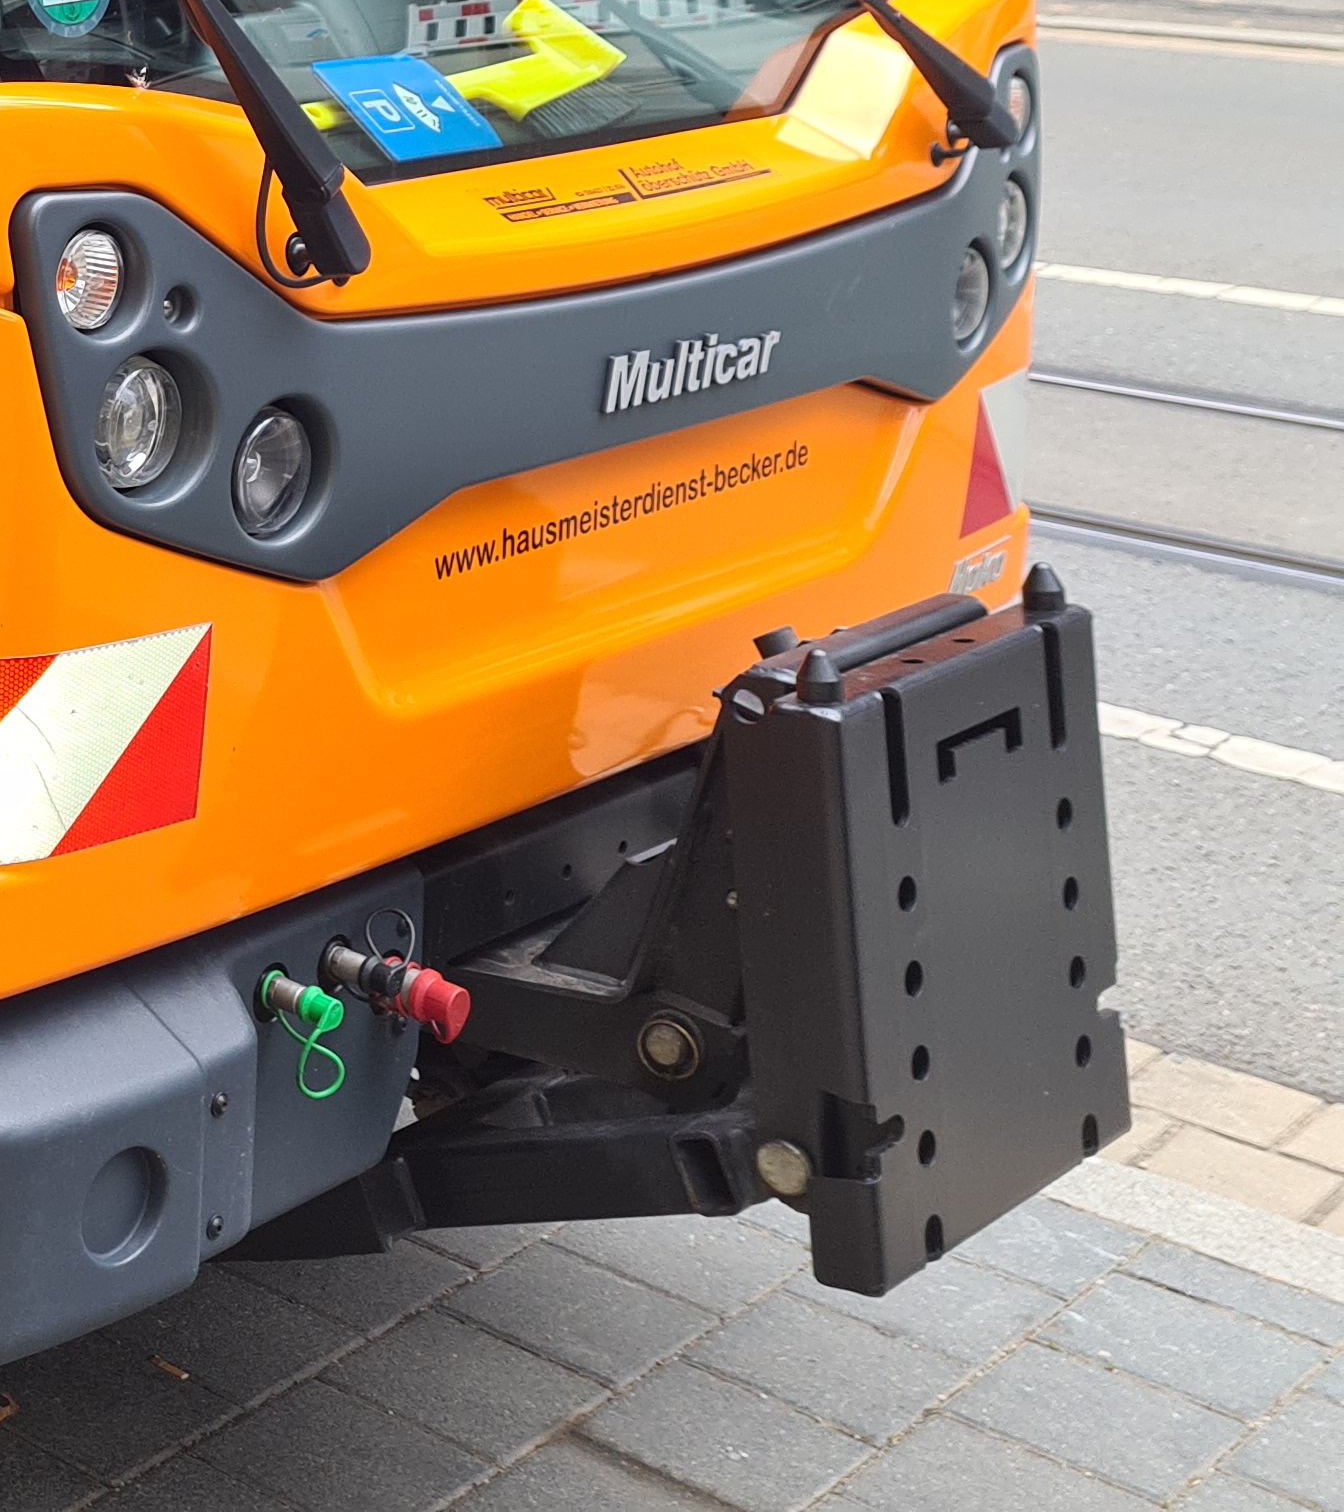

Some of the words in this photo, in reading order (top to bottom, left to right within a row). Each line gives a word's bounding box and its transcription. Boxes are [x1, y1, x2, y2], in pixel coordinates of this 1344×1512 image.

[709, 159, 755, 178] GmbH
[601, 329, 782, 415] Multicar
[433, 438, 810, 582] www.hausmeisterdienst-becker.de
